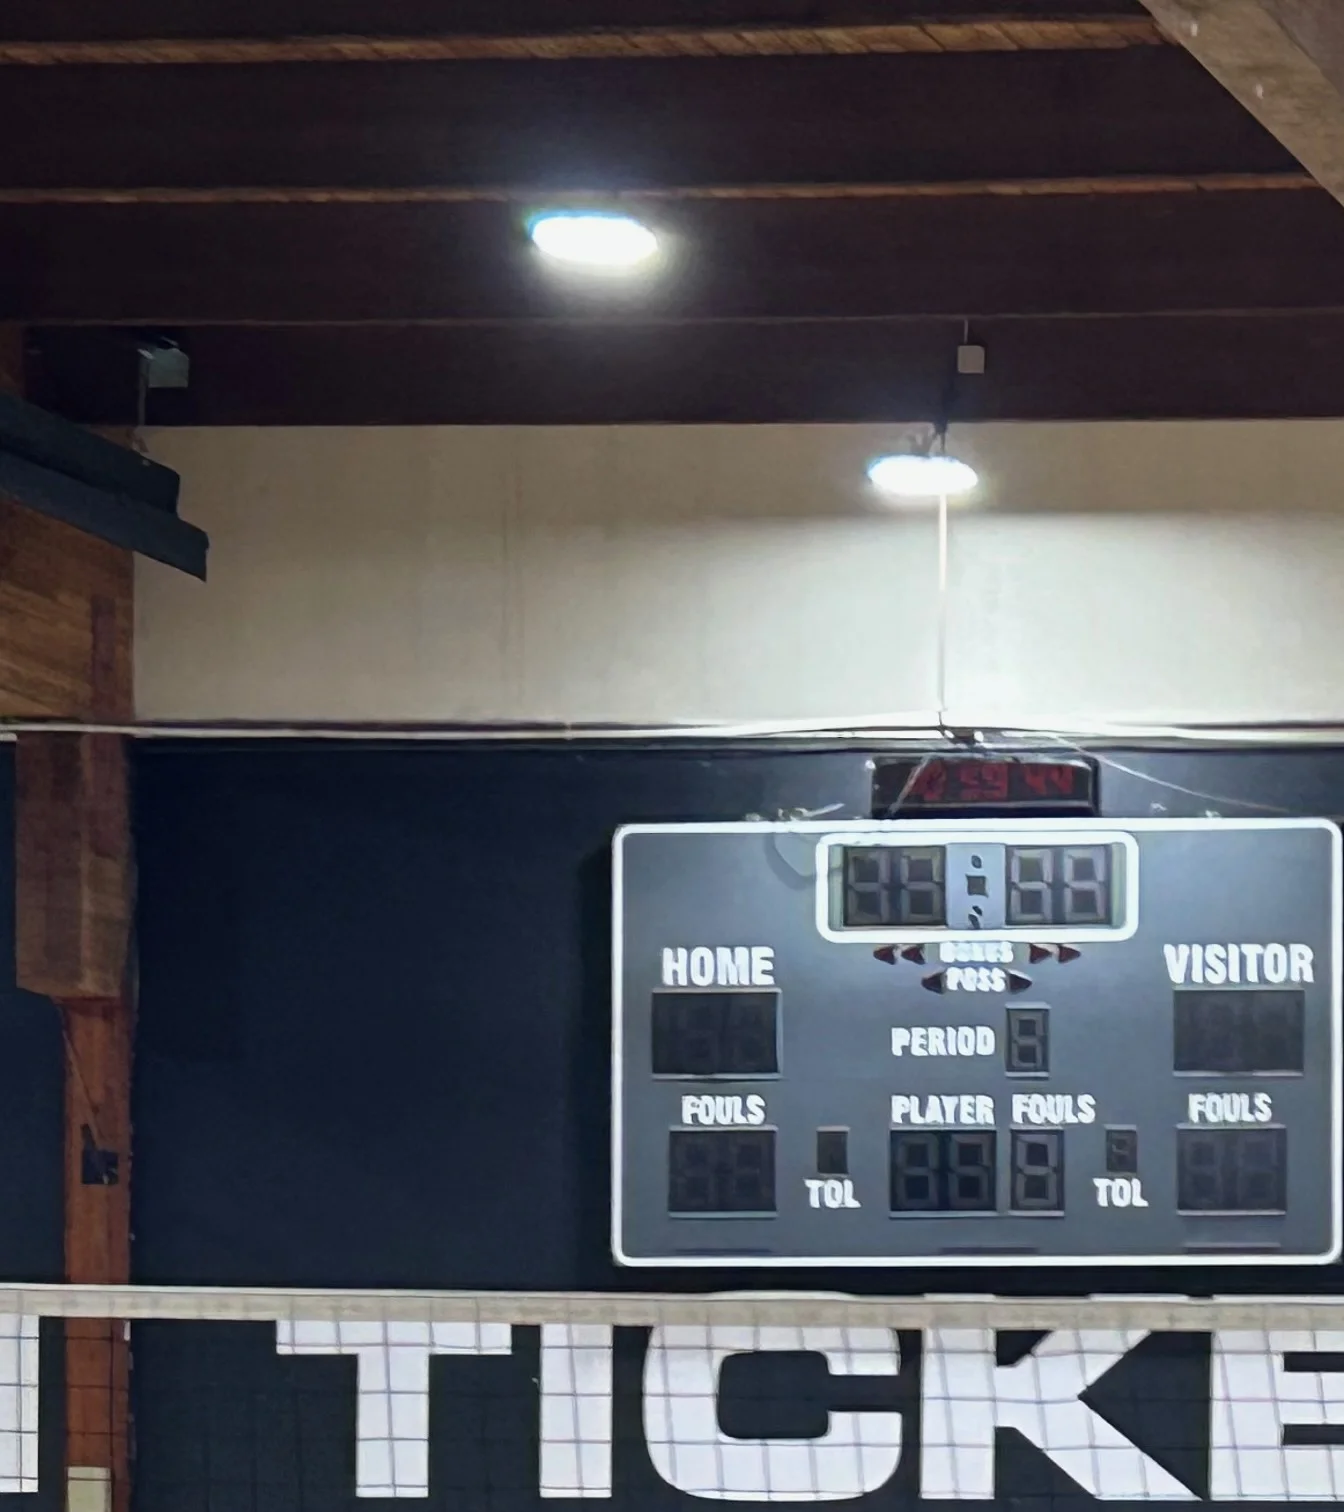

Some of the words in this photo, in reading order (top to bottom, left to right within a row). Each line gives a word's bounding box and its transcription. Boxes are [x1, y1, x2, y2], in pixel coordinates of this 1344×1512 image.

[662, 946, 775, 987] HOME
[1163, 943, 1315, 984] VISITOR
[891, 1025, 996, 1056] PERIOD
[681, 1094, 766, 1126] FOULS
[891, 1094, 996, 1125] PLAYER
[1012, 1093, 1097, 1125] FOULS
[1188, 1092, 1273, 1123] FOULS
[804, 1178, 861, 1208] TOL
[1092, 1177, 1149, 1207] TOL
